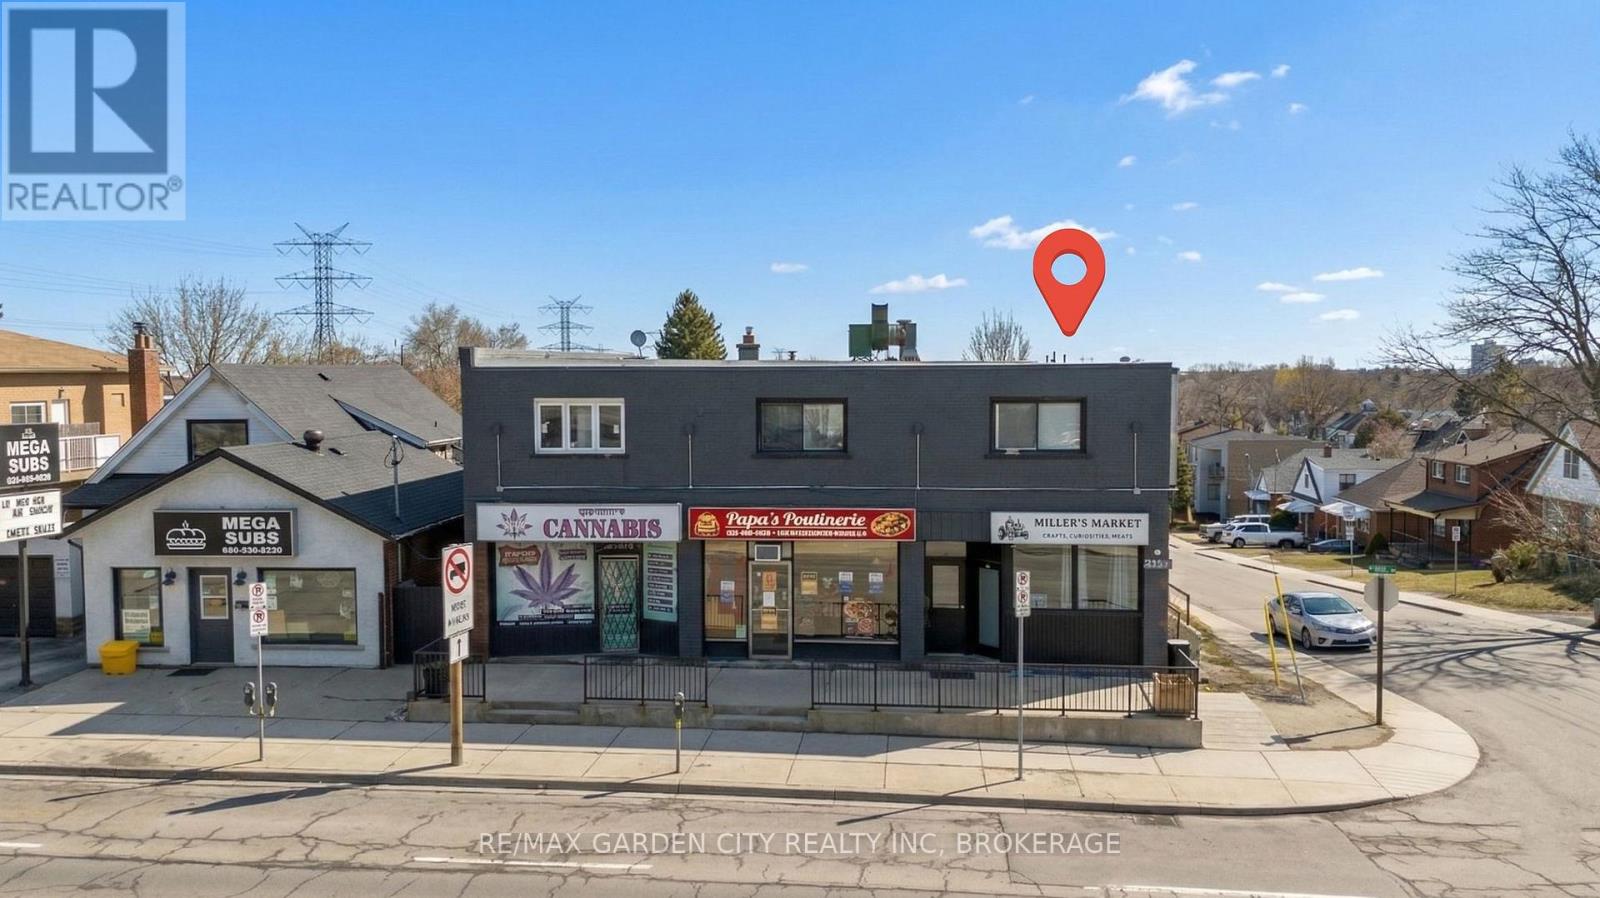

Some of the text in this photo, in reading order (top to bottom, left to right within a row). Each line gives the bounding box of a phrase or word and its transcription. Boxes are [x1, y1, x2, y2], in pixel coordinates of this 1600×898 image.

[6, 439, 51, 457] MEGA
[8, 456, 50, 474] SUBS
[222, 516, 281, 530] MEGA
[543, 518, 663, 539] CANNABIS
[726, 511, 867, 530] Papa's Poutinerie
[1034, 518, 1142, 528] MILLER'S MARKET
[224, 531, 280, 545] SUBS
